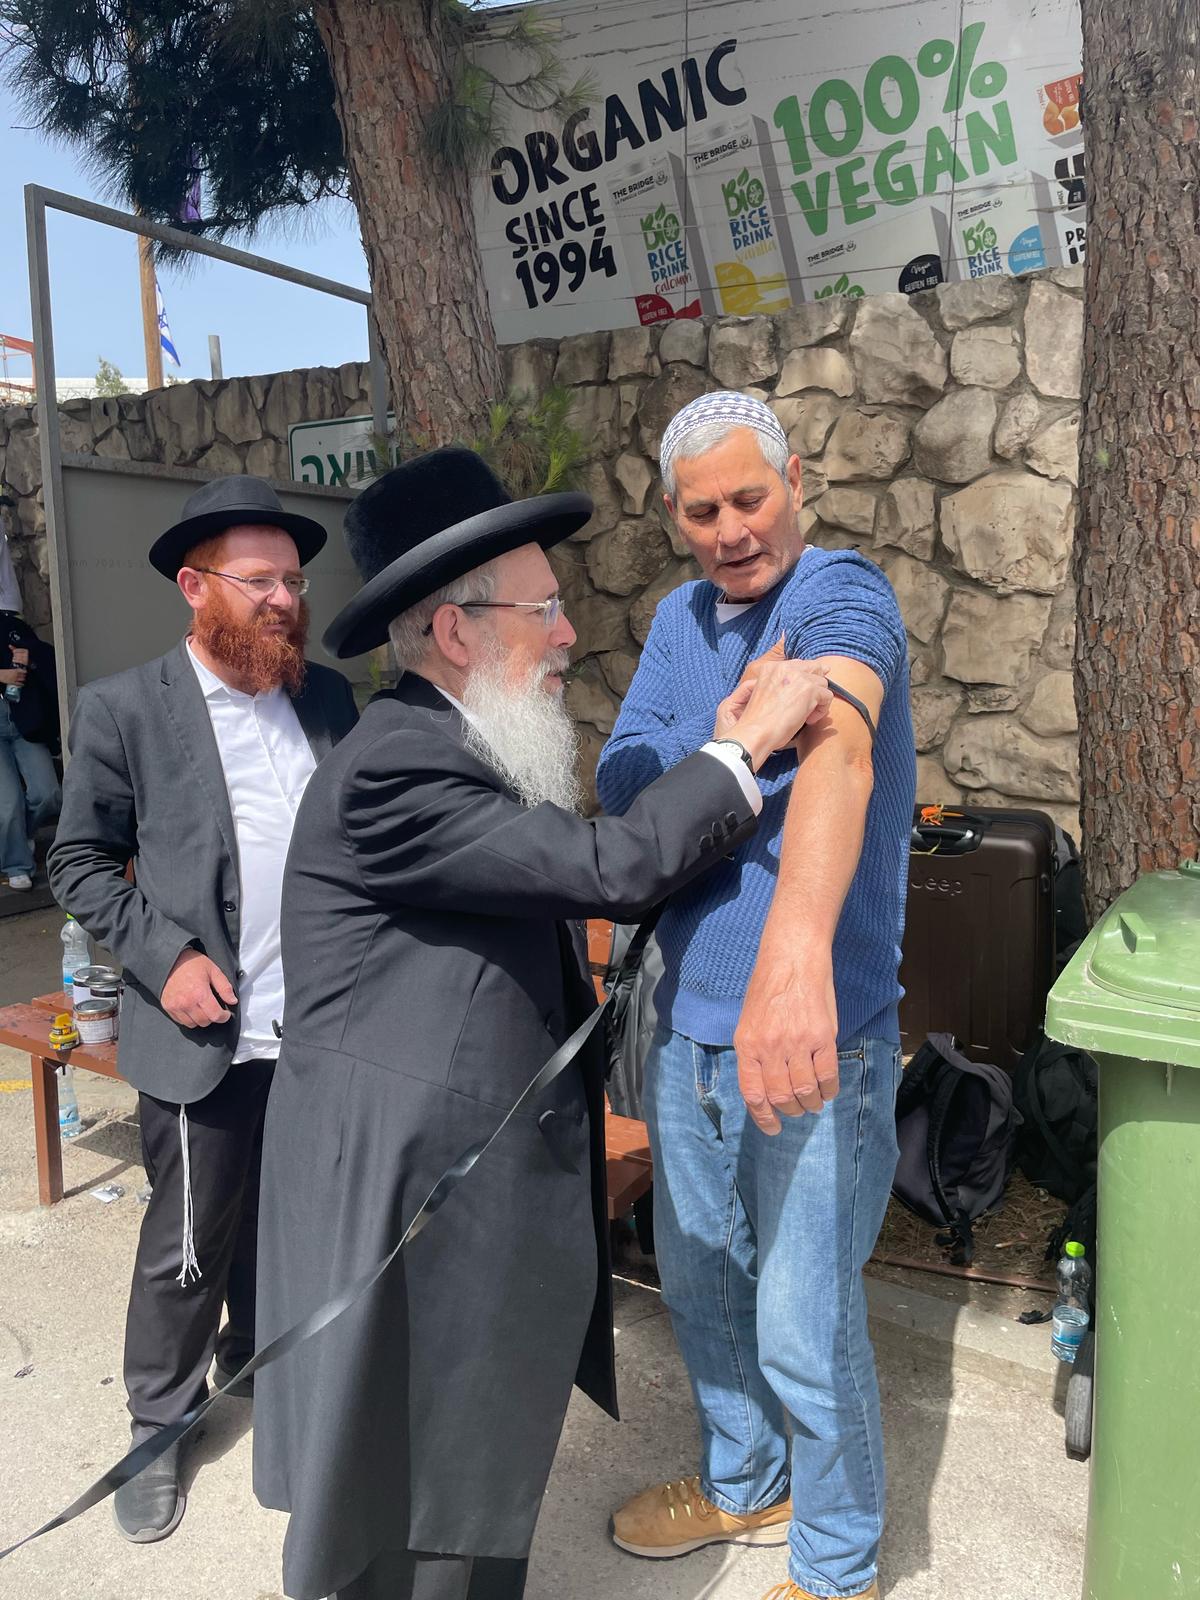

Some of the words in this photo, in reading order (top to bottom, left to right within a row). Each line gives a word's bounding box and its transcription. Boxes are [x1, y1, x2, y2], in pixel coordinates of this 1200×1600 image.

[773, 21, 1008, 176] 100%
[491, 39, 747, 205] ORGANIC
[693, 151, 709, 164] THE
[709, 139, 738, 158] BRIDGE
[790, 100, 1018, 237] VEGAN
[612, 187, 628, 199] THE
[628, 175, 655, 193] BRIDGE
[506, 182, 605, 259] SINCE
[729, 206, 770, 237] RICE
[733, 224, 774, 250] DRINK
[516, 226, 617, 309] 1994
[648, 240, 687, 270] RICE
[651, 257, 690, 283] DRINK
[968, 246, 1001, 270] RICE
[970, 260, 1003, 278] DRINK
